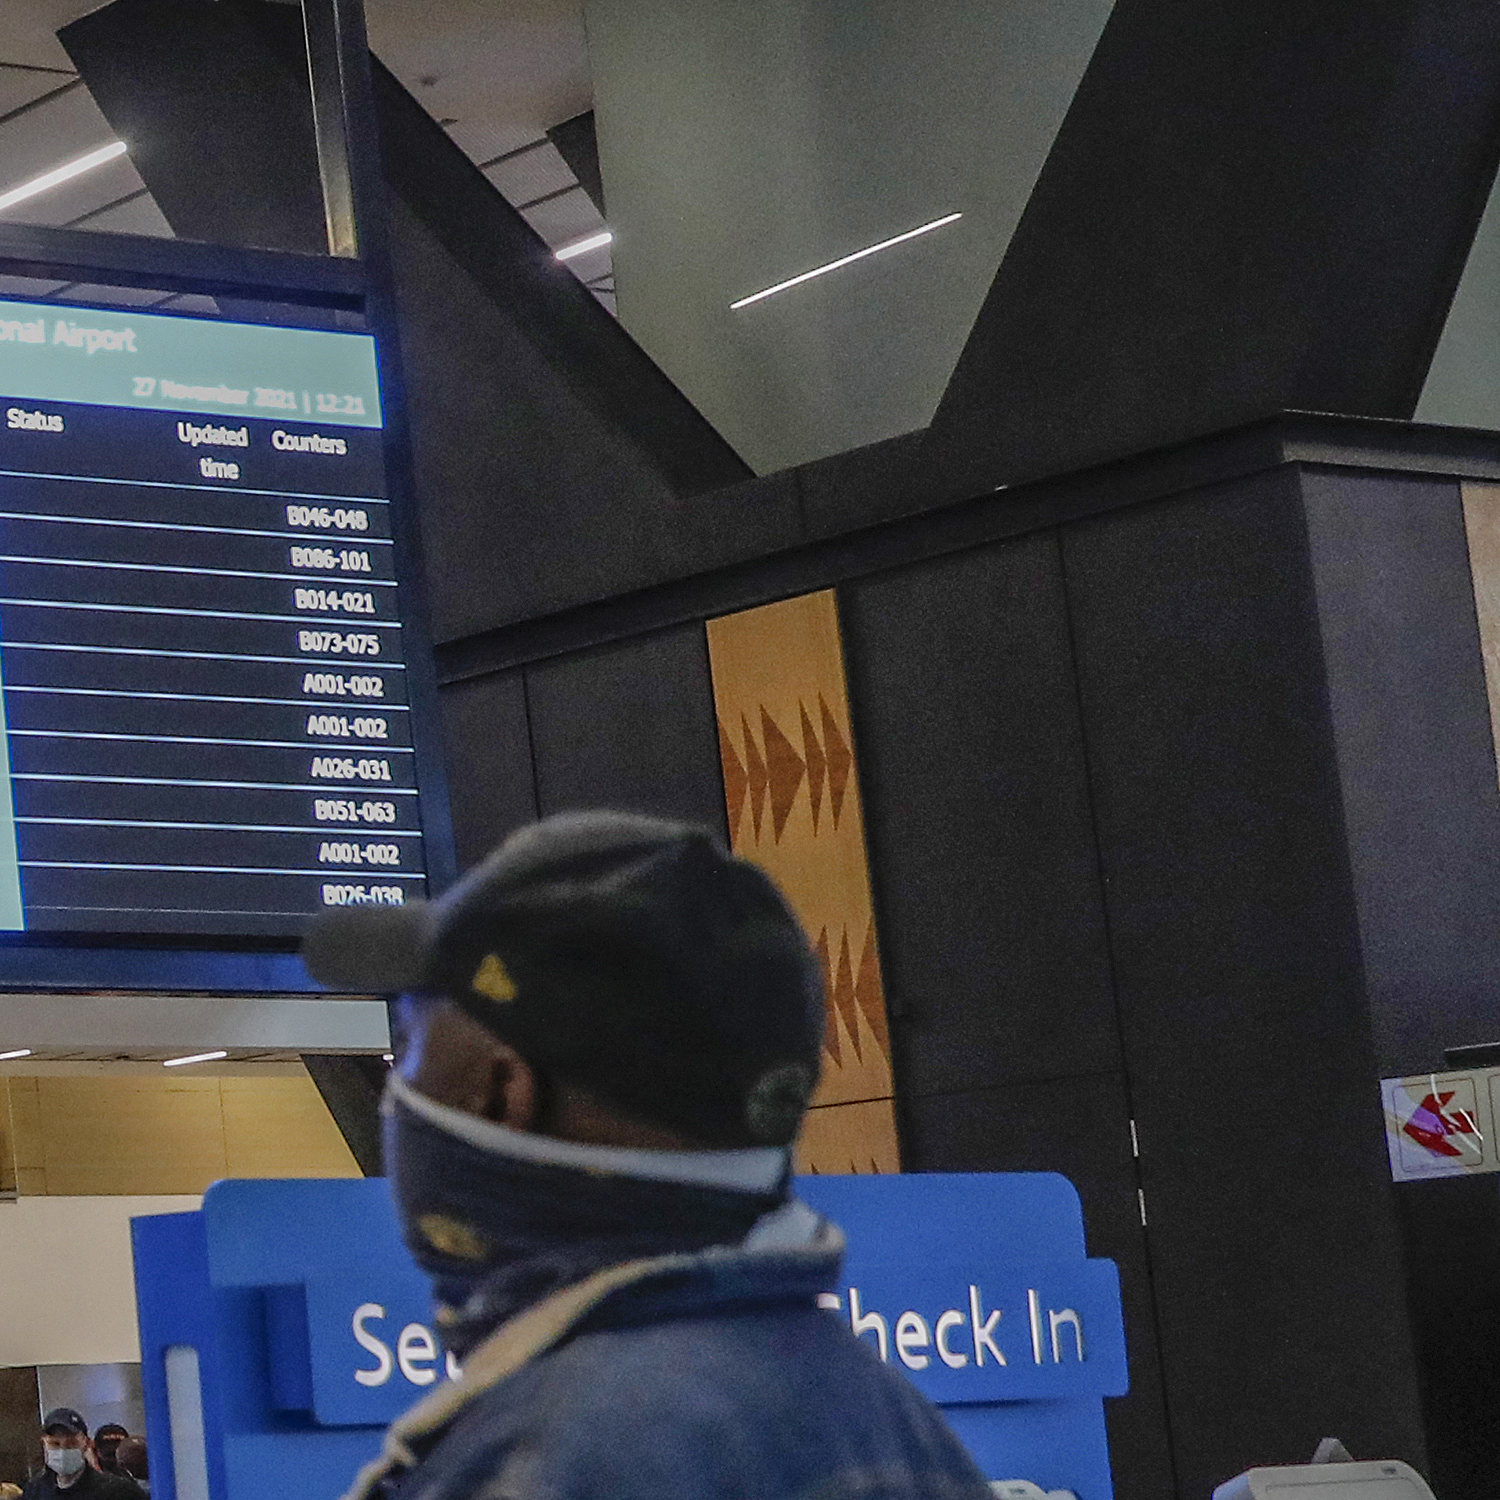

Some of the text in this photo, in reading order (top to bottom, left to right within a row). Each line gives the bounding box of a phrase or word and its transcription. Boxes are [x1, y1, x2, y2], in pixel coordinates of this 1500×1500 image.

[54, 321, 136, 353] Airport
[7, 408, 63, 431] Status
[178, 422, 248, 446] Updated
[273, 431, 346, 454] Counters
[200, 458, 238, 479] time
[287, 506, 367, 530] B046-048
[291, 547, 371, 571] B086-101
[295, 589, 375, 613] B014-021
[299, 631, 379, 654] B073-075
[304, 674, 383, 696] A001-002
[308, 716, 387, 738] A001-002
[312, 757, 391, 780] A026-031
[315, 800, 395, 822] B051-063
[320, 843, 399, 864] A001-002
[352, 1285, 1084, 1387] Se heck In
